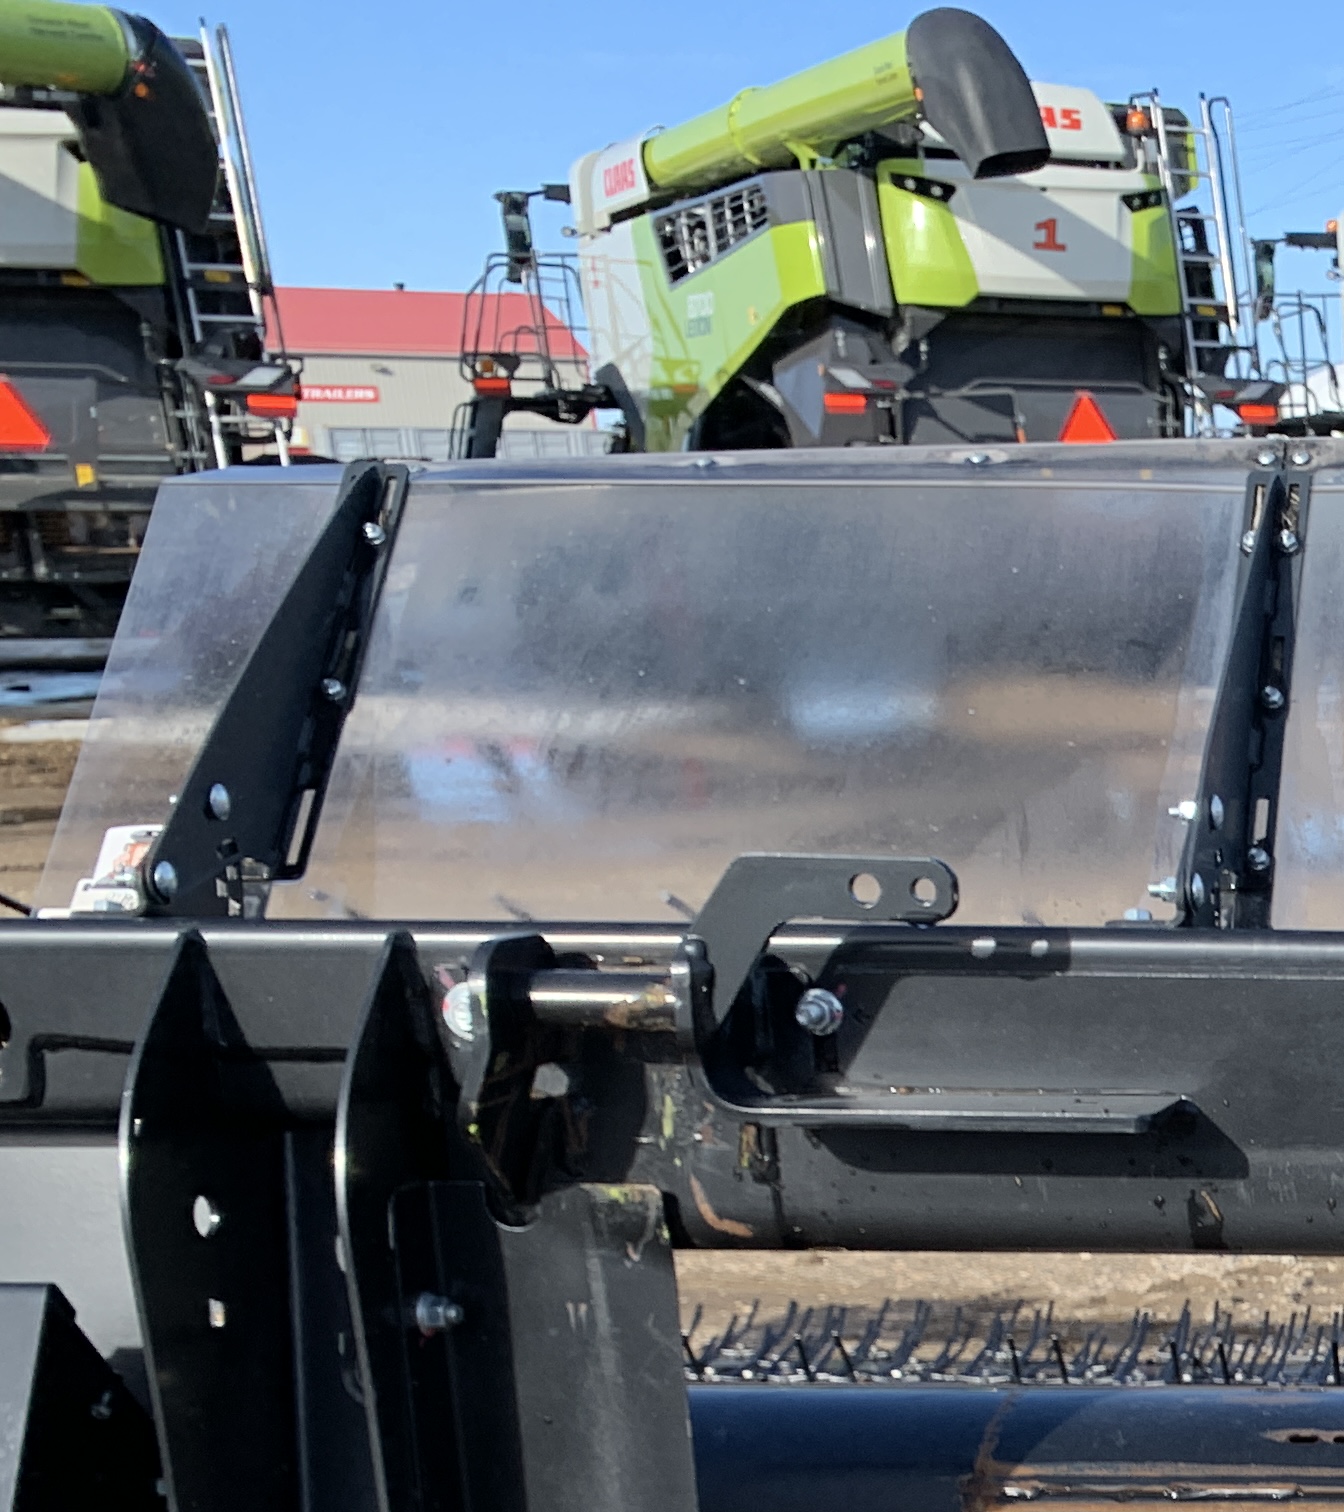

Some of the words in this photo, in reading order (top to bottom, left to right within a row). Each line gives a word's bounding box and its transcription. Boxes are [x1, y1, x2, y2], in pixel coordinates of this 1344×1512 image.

[603, 158, 636, 198] CLAAS
[1033, 218, 1067, 252] 1
[301, 387, 375, 399] TRAILERS
